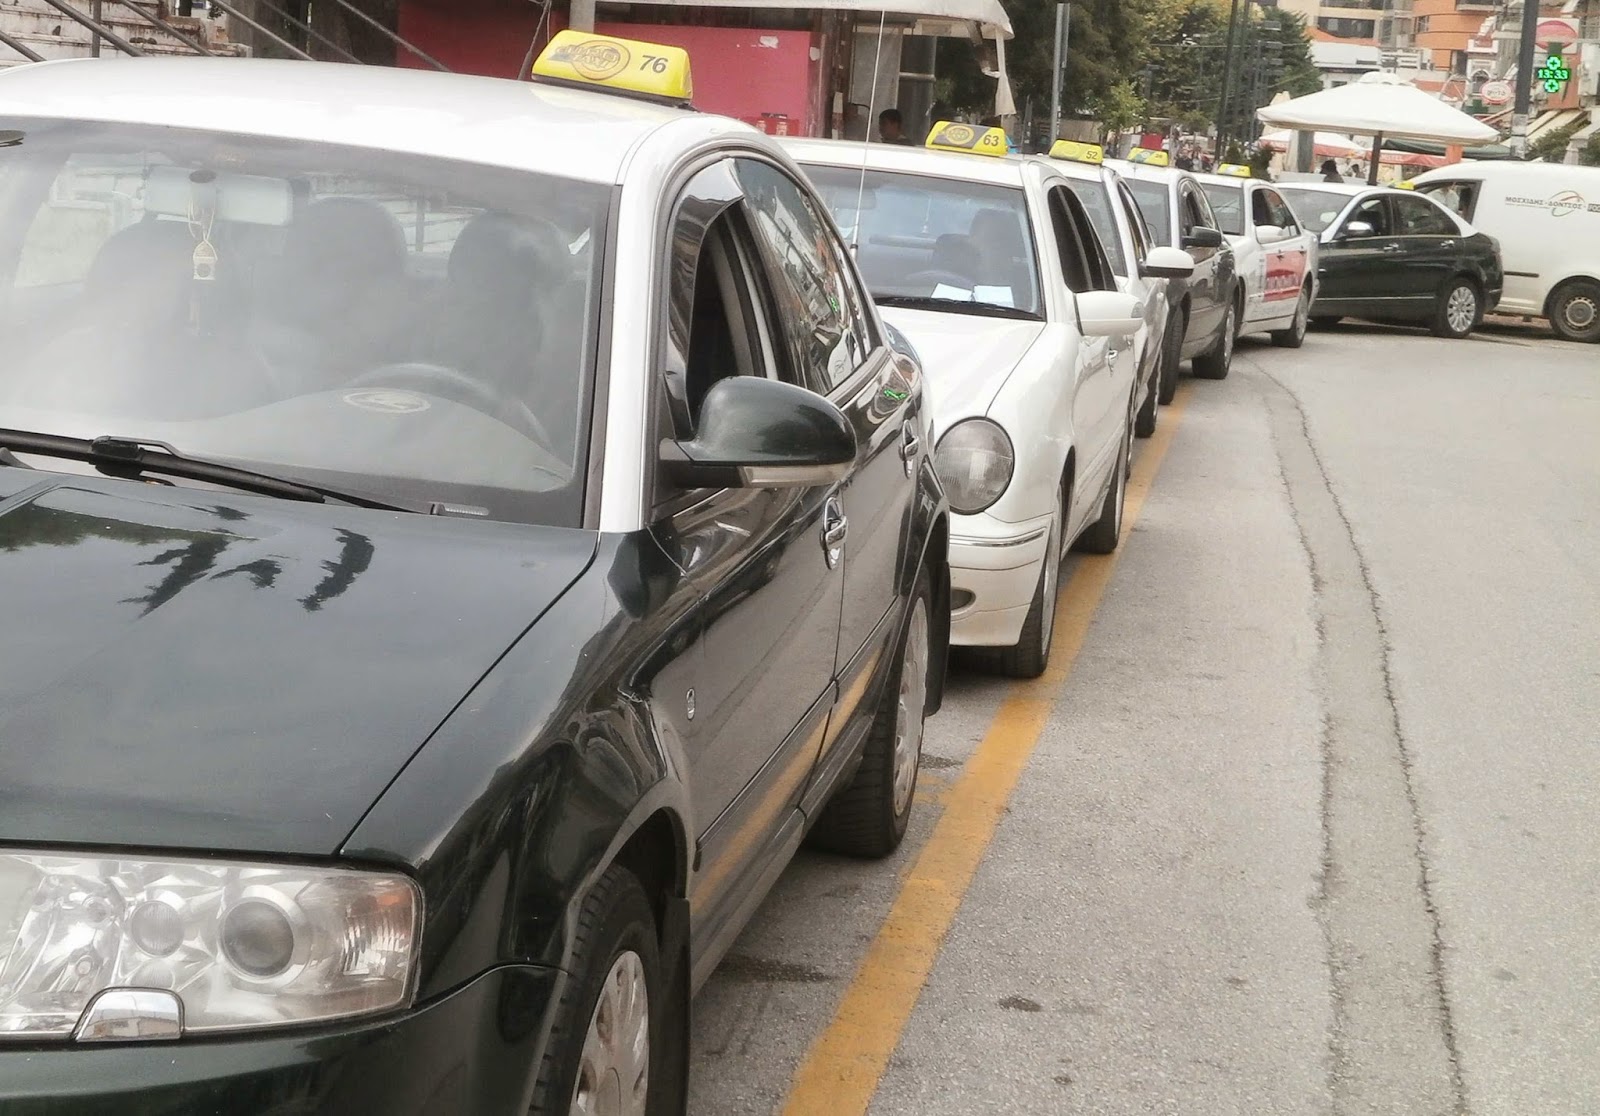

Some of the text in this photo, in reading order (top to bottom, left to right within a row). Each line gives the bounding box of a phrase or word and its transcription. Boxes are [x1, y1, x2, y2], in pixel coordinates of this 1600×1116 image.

[639, 55, 668, 74] 76
[1537, 69, 1568, 80] 13:33
[983, 135, 999, 147] 63
[1086, 151, 1098, 160] 52
